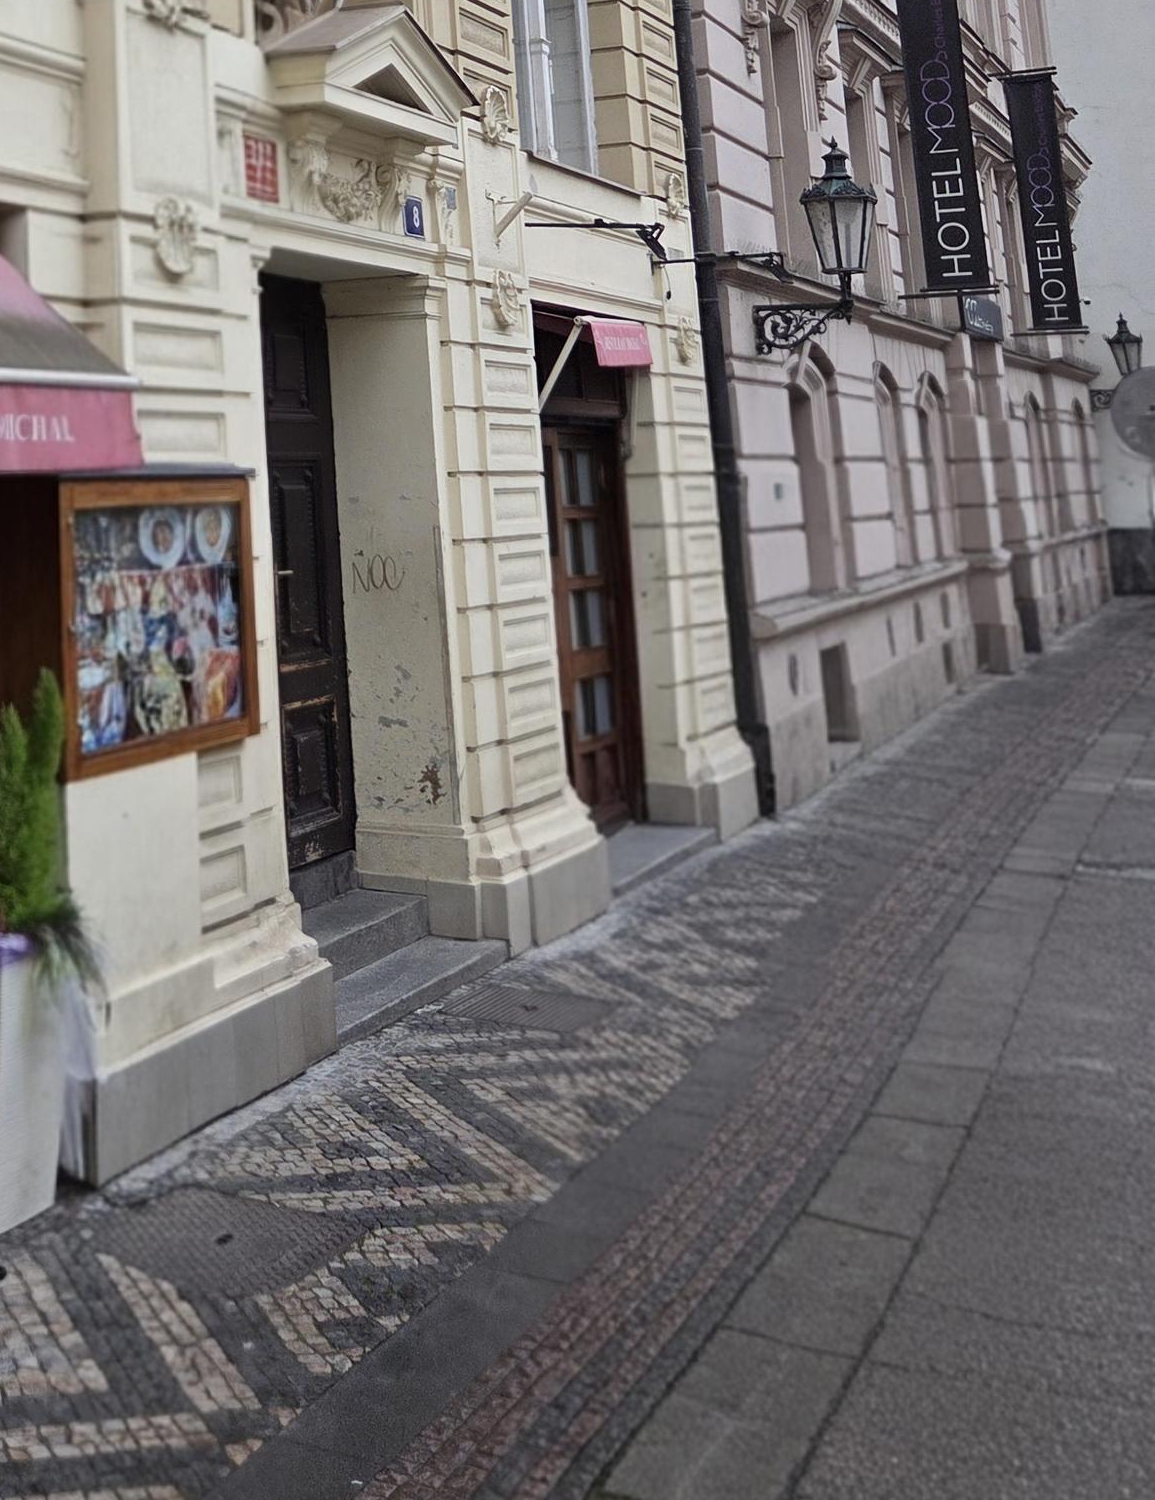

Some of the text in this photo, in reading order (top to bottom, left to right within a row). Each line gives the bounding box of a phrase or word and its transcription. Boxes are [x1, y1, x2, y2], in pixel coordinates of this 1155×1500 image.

[412, 205, 420, 229] 8
[930, 157, 973, 277] HOTEL
[1034, 229, 1070, 321] HOTEL
